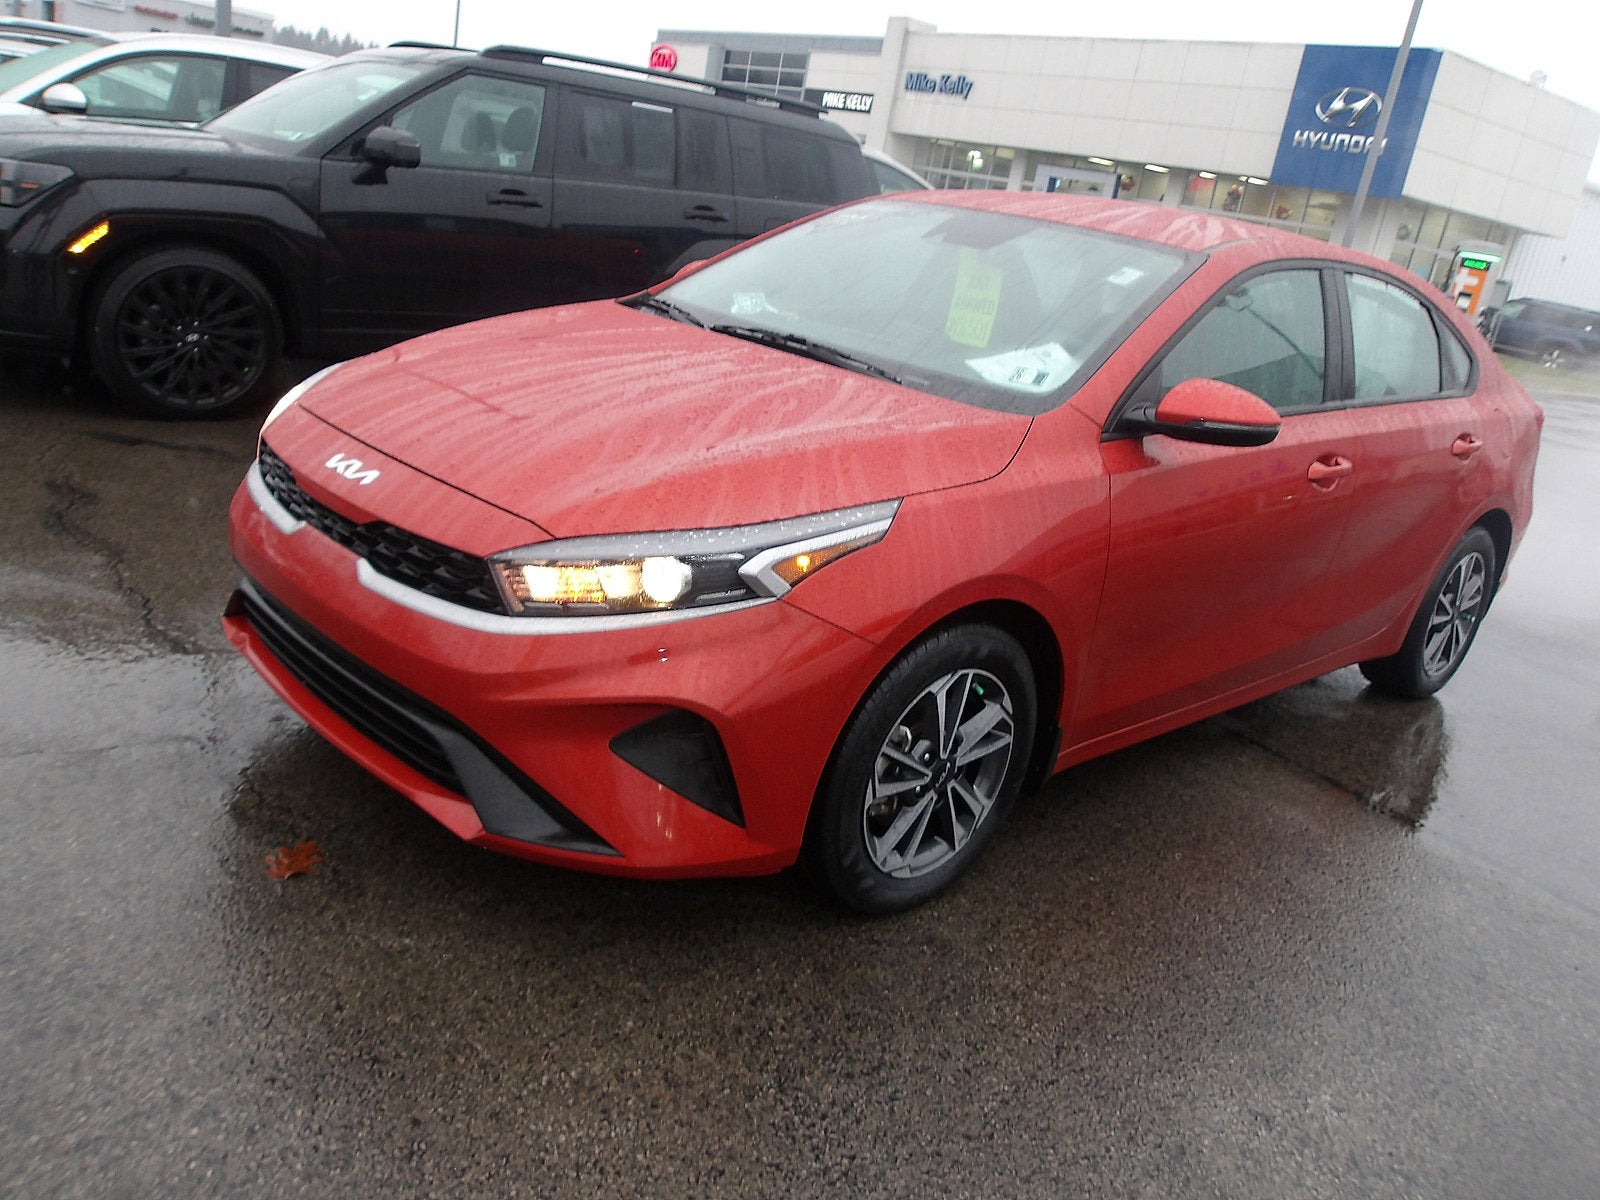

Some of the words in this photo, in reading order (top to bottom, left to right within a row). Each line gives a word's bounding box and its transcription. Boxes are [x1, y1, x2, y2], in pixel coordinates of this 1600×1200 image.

[905, 72, 936, 93] Mike
[939, 74, 974, 100] Kelly
[822, 91, 845, 108] MIKE
[845, 93, 873, 111] KELLY
[325, 453, 380, 486] KIA
